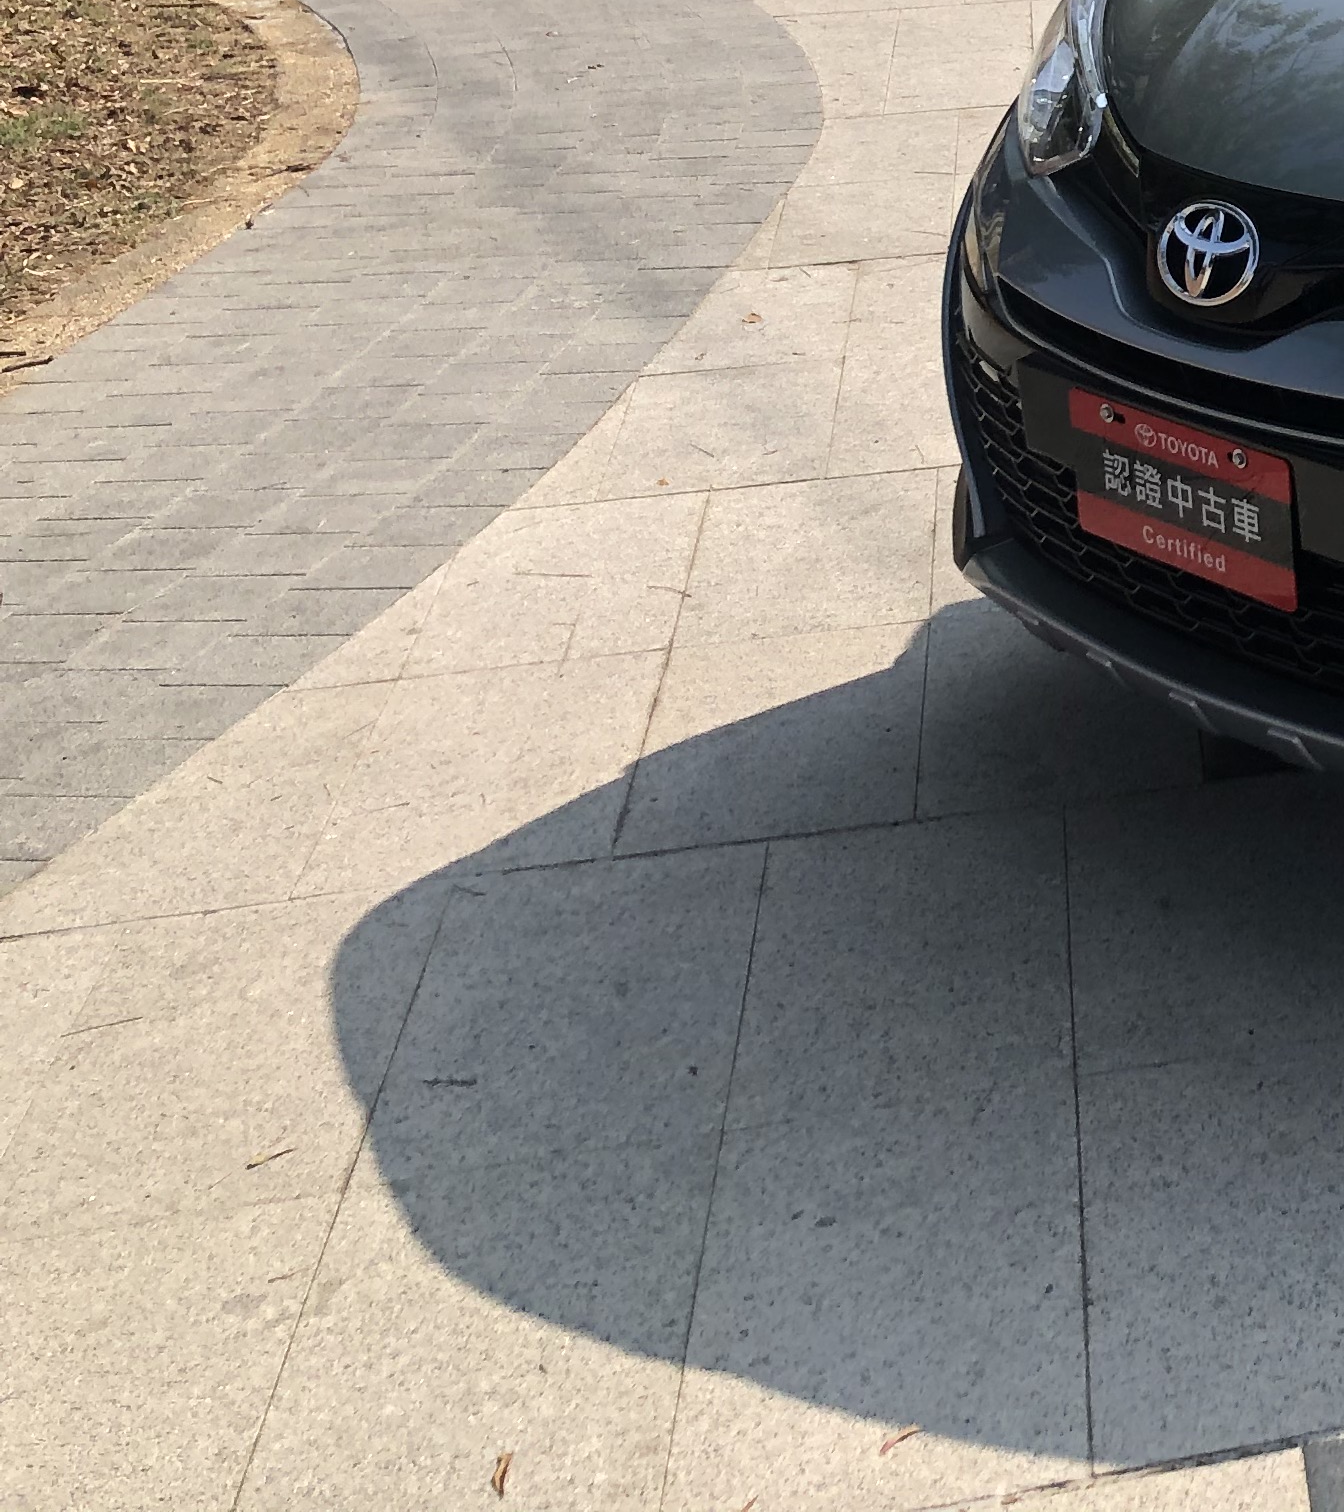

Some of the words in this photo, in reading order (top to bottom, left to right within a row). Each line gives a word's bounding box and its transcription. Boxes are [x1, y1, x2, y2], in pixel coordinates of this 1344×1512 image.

[1157, 433, 1219, 469] TOYOTA
[1102, 448, 1262, 544] 認證中古車
[1142, 525, 1227, 573] Certified
